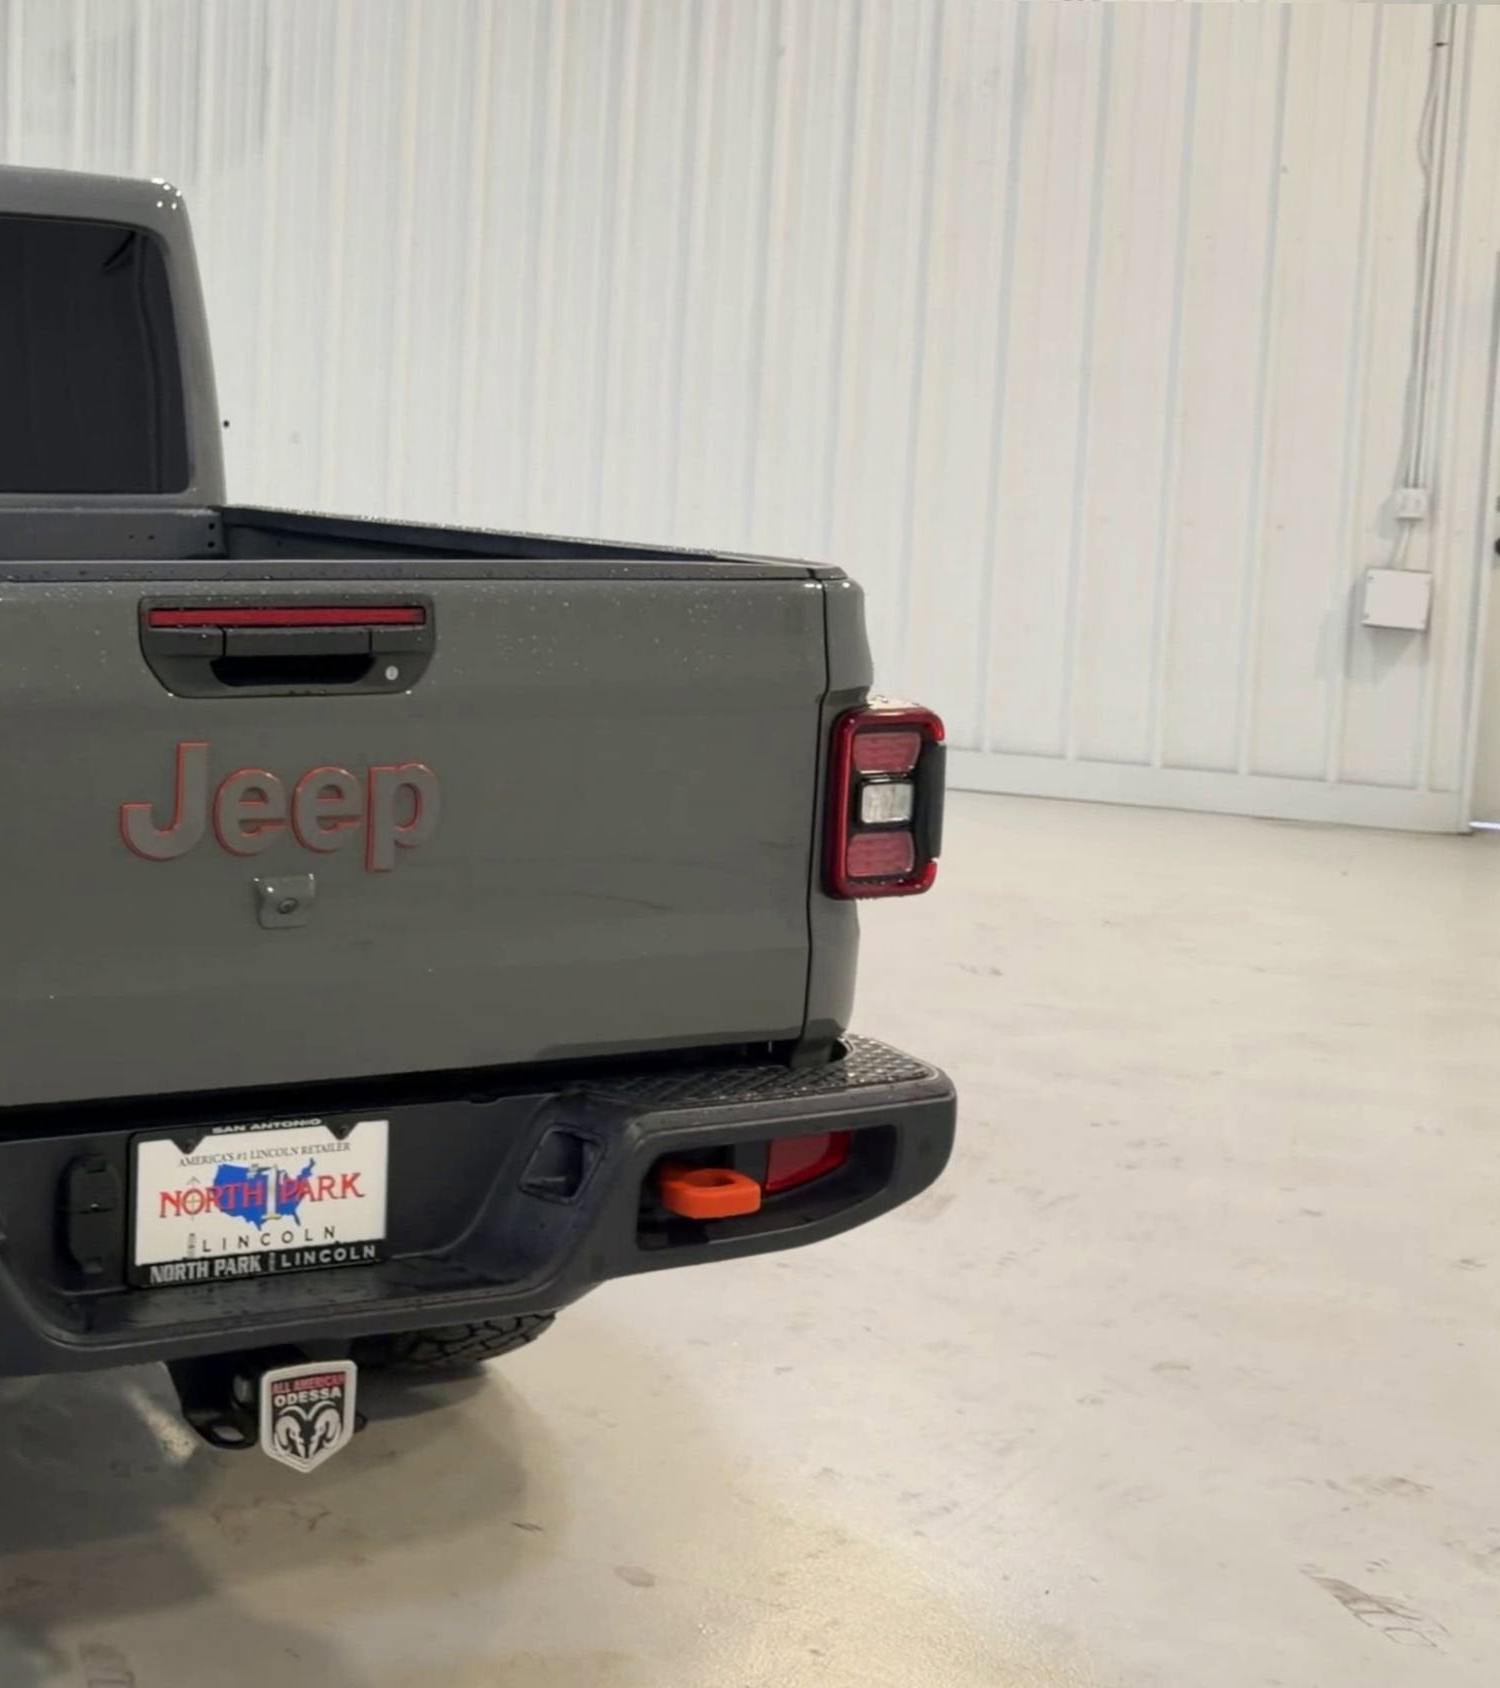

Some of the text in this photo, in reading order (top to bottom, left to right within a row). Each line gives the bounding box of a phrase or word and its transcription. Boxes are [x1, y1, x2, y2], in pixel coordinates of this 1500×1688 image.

[119, 740, 440, 873] Jeep
[212, 1118, 322, 1135] SAN ANTONIO
[250, 1145, 299, 1160] LINCOLN
[301, 1140, 351, 1156] RETAILER
[159, 1172, 365, 1219] NORTH PARK
[202, 1226, 336, 1253] LINCOLN
[150, 1259, 209, 1285] NORTH
[213, 1254, 262, 1278] PARK
[280, 1244, 377, 1269] LINCOLN
[274, 1386, 342, 1408] ODESSA
